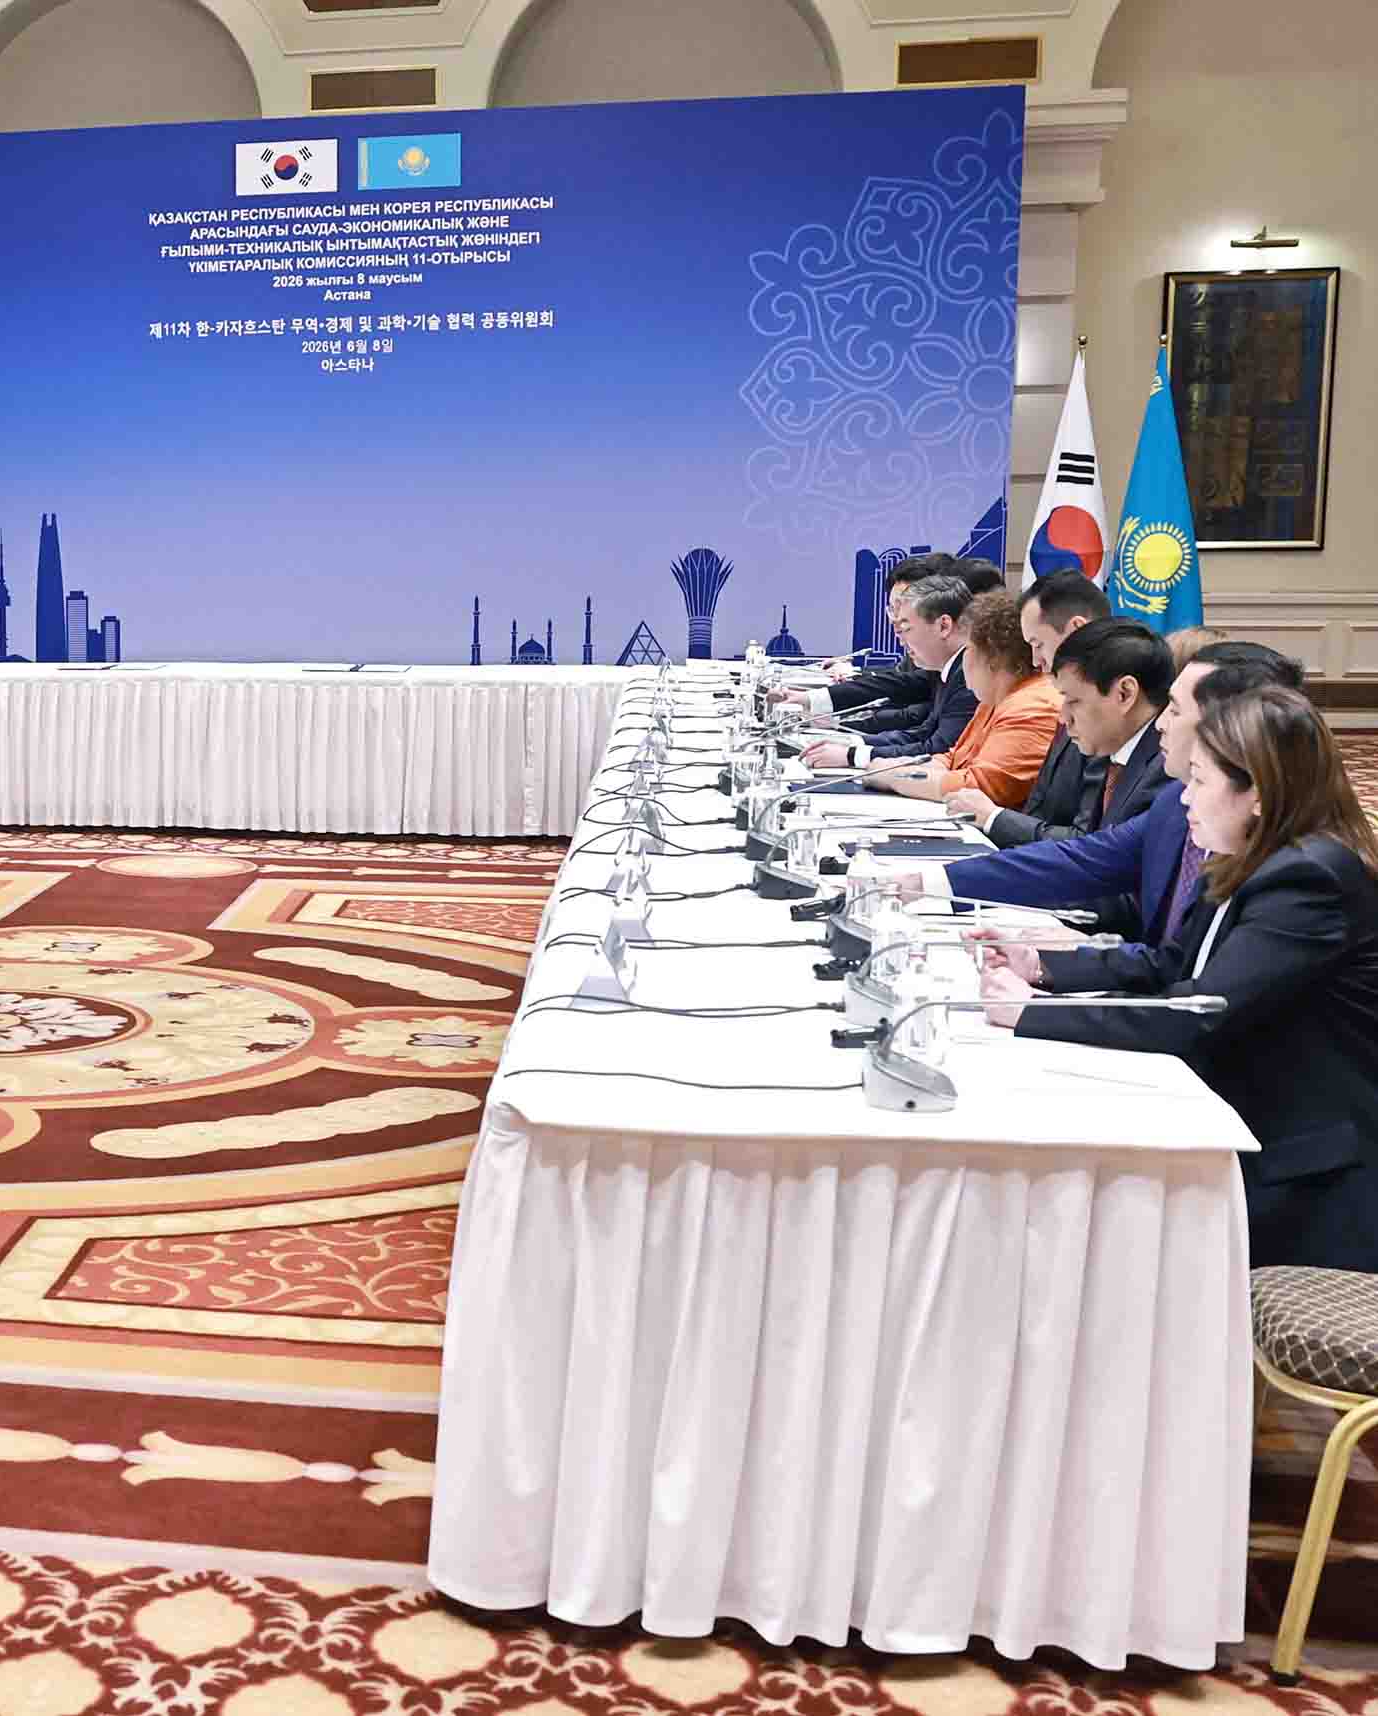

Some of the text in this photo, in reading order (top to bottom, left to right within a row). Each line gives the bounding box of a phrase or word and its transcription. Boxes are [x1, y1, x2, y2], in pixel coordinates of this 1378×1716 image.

[148, 196, 554, 227] ҚАЗАҚСТАН РЕСПУБЛИКАСЫ МЕН КОРЕЯ РЕСПУБЛИКАСЫ
[189, 215, 510, 240] АРАСЫНДАҒЫ САУДА-ЭКОНОМИКАЛЫҚ ЖӘНЕ
[160, 231, 541, 258] ҒЫЛЫМИ-ТЕХНИКАЛЫҚ ЫНТЫМАҚТАСТЫҚ ЖӨНІНДЕГІ
[188, 250, 511, 273] ҮКІМЕТАРАЛЫҚ КОМИССИЯНЫҢ 11-ОТЫРЫСЫ
[272, 273, 423, 287] 2026 жылғы 8 маусым
[324, 289, 372, 301] Астана
[149, 321, 192, 338] 제11차
[195, 318, 286, 337] 한-카자흐스탄
[359, 315, 372, 333] 및
[446, 312, 475, 330] 협력
[480, 310, 554, 329] 공동위원회
[301, 338, 394, 354] 2026년 6월 8일
[321, 357, 375, 373] 아스타나
